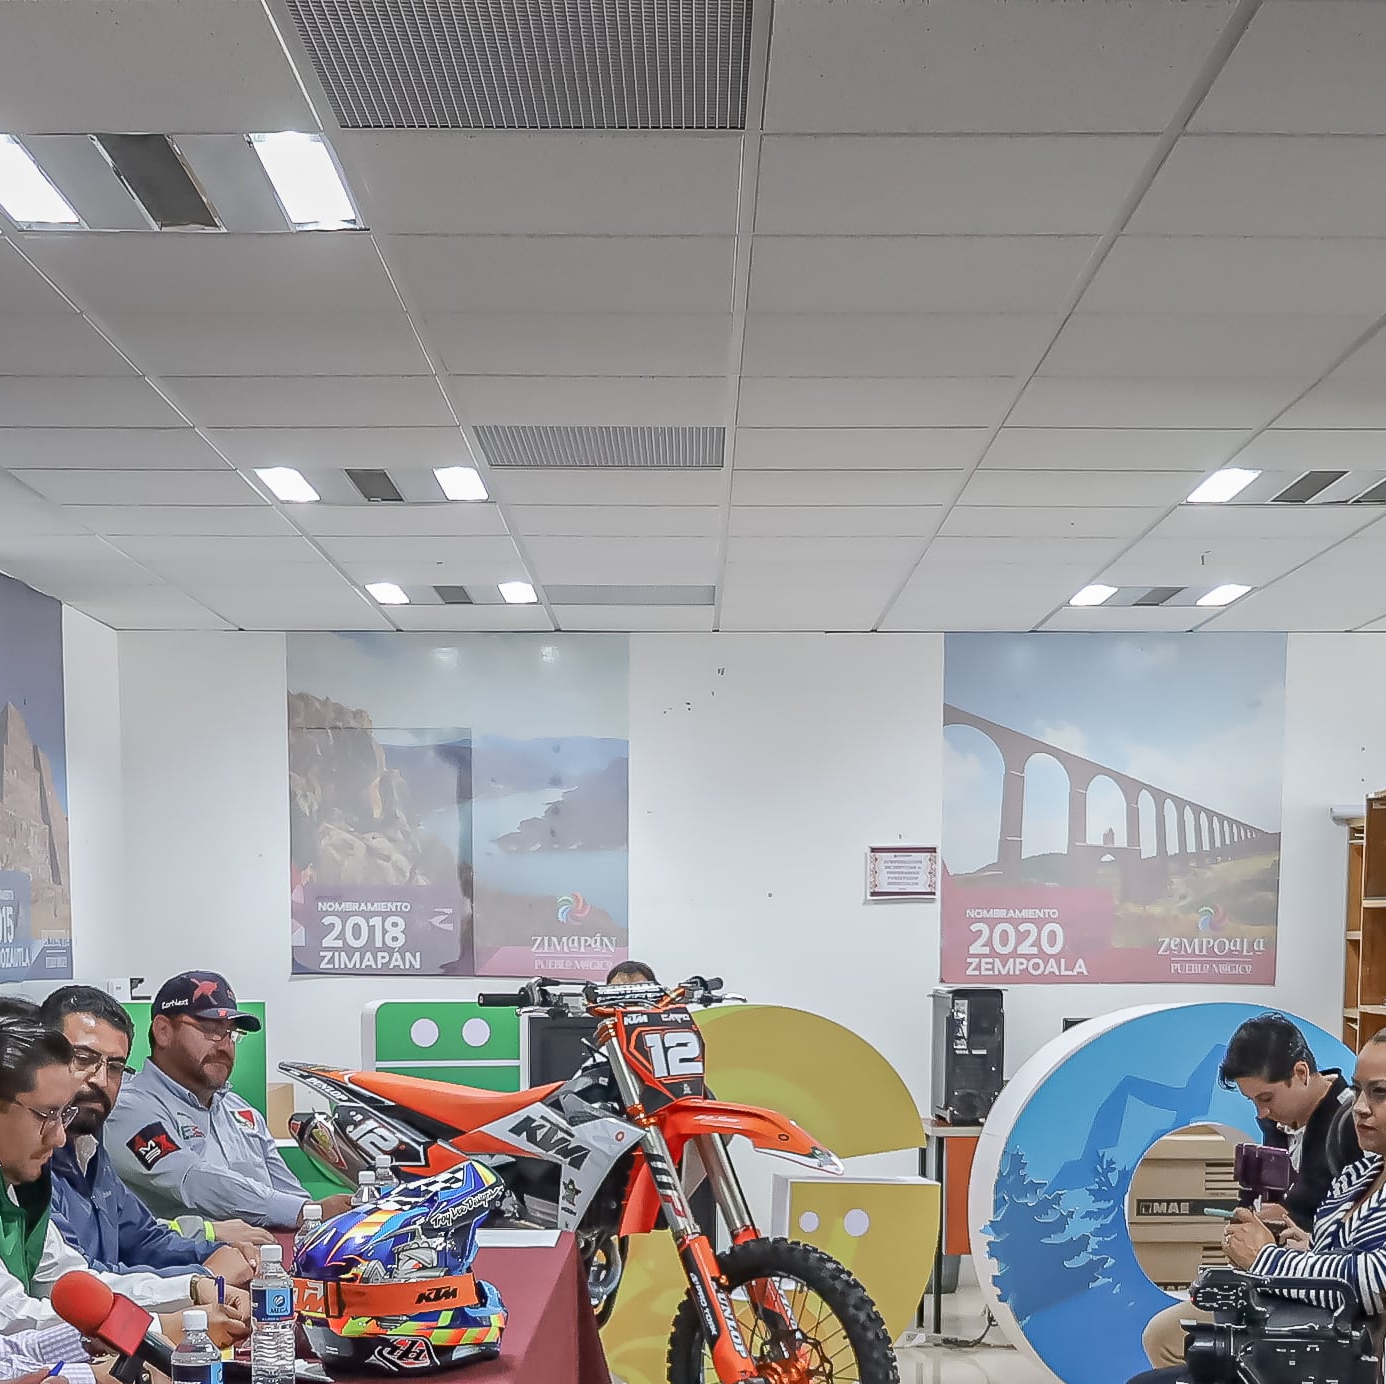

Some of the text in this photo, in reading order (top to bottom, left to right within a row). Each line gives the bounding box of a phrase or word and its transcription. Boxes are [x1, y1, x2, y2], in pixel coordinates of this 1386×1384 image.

[317, 901, 411, 913] NOMBRAMIENTO
[965, 908, 1059, 919] NOMBRAMIENTO
[321, 915, 406, 949] 2018
[968, 922, 1064, 955] 2020
[319, 947, 421, 970] ZIMAPÁN
[965, 957, 1089, 976] ZEMPOALA
[644, 1032, 704, 1079] 12
[507, 1115, 592, 1171] KTM
[414, 1286, 459, 1305] KTM
